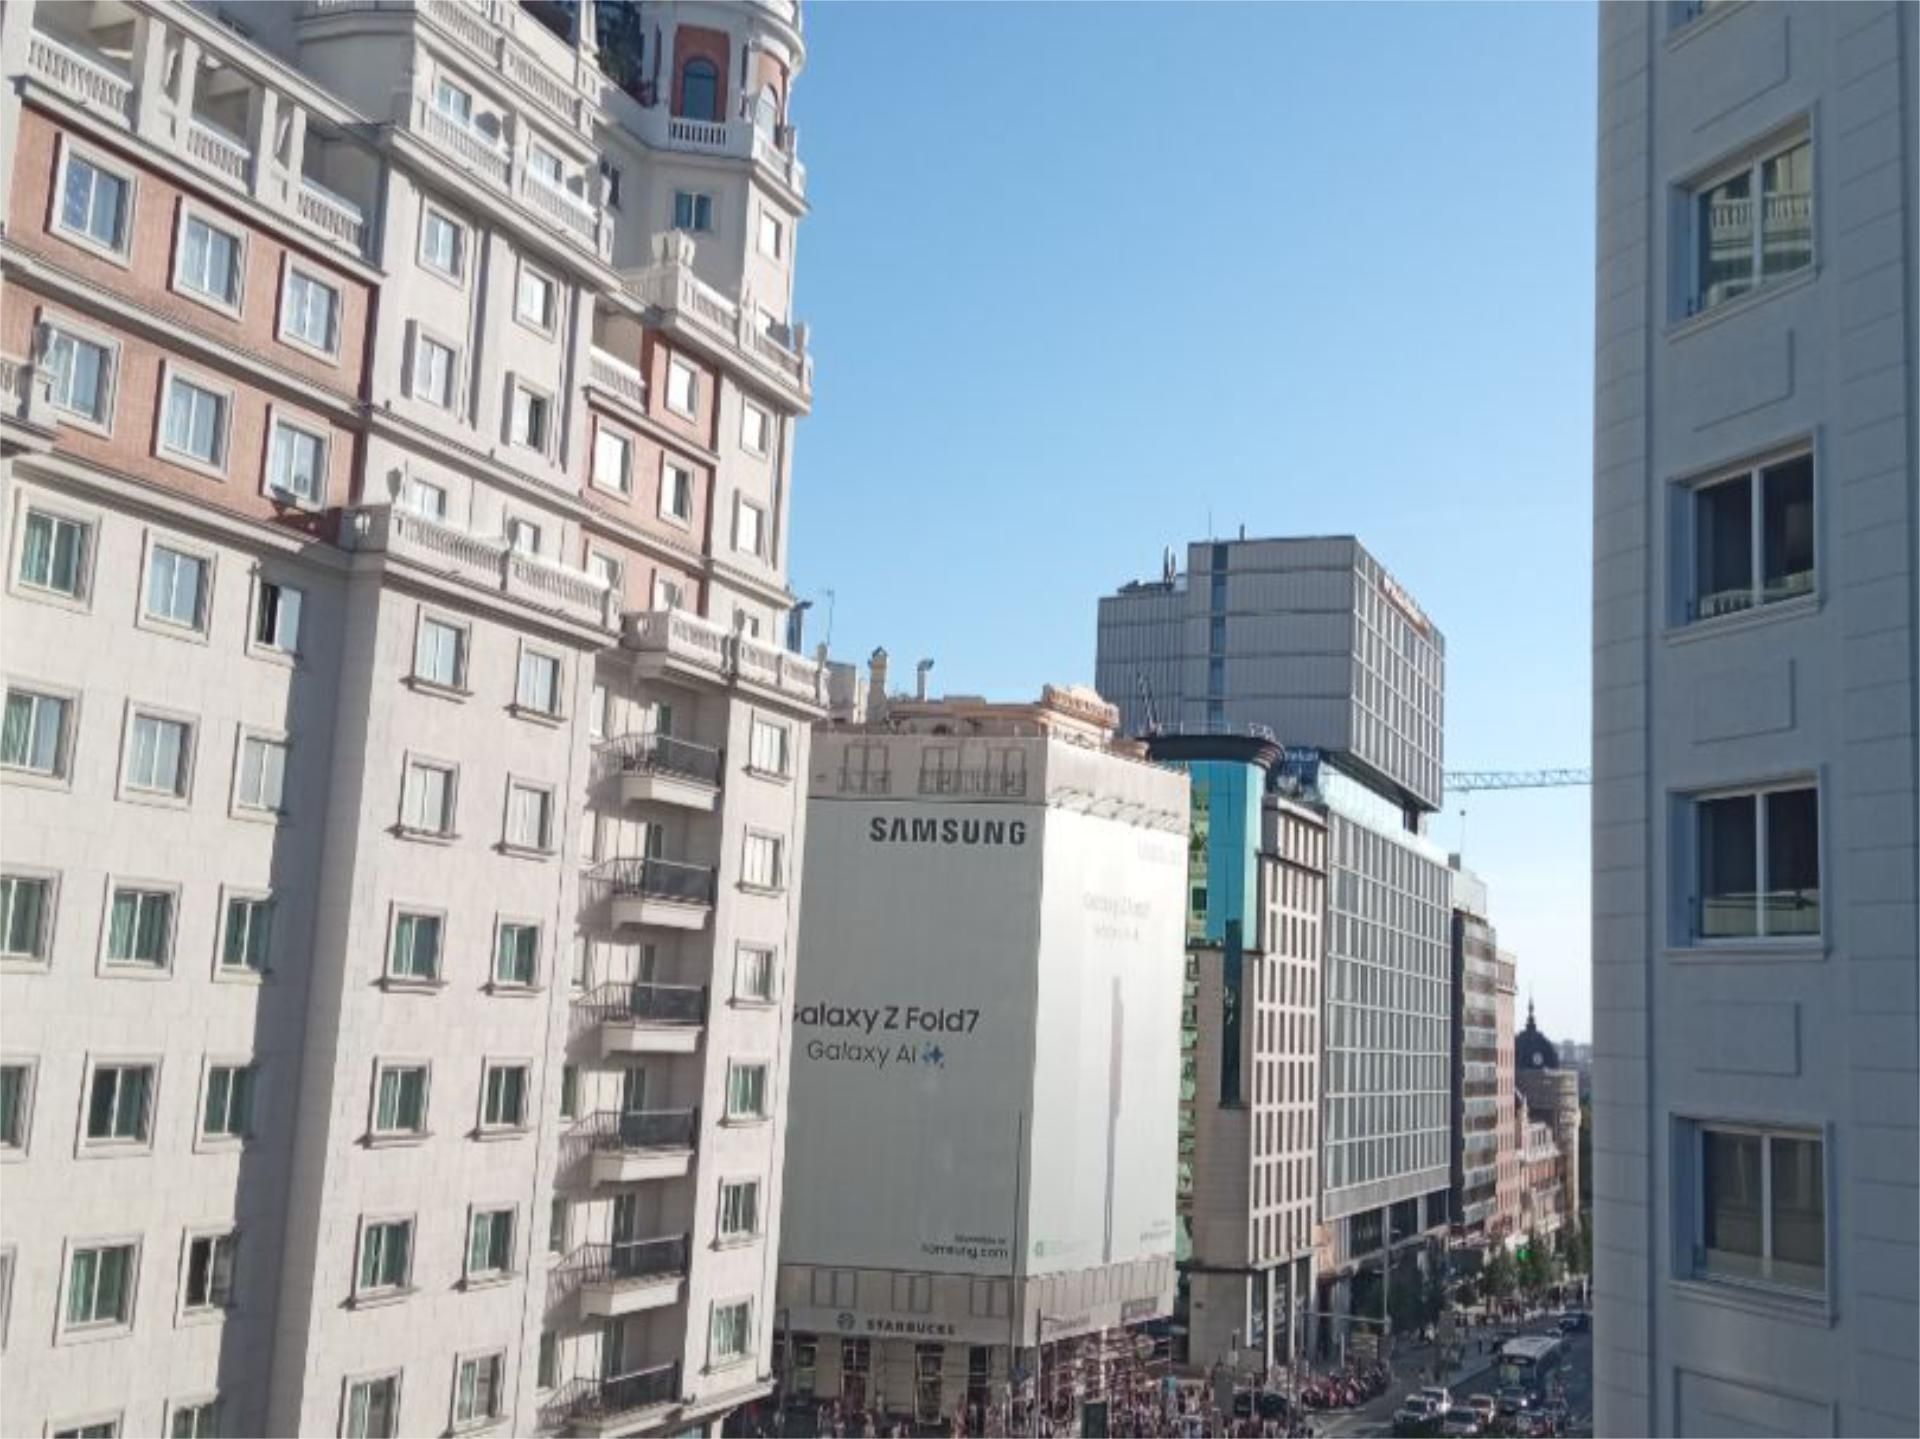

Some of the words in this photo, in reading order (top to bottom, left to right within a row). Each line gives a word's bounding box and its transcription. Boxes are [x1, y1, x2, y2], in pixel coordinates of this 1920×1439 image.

[870, 817, 1027, 845] SAMSUNG
[884, 1005, 900, 1030] Z
[906, 1006, 980, 1033] Fold7
[808, 1039, 891, 1069] Galaxy
[866, 1318, 956, 1335] STARBUCKS
